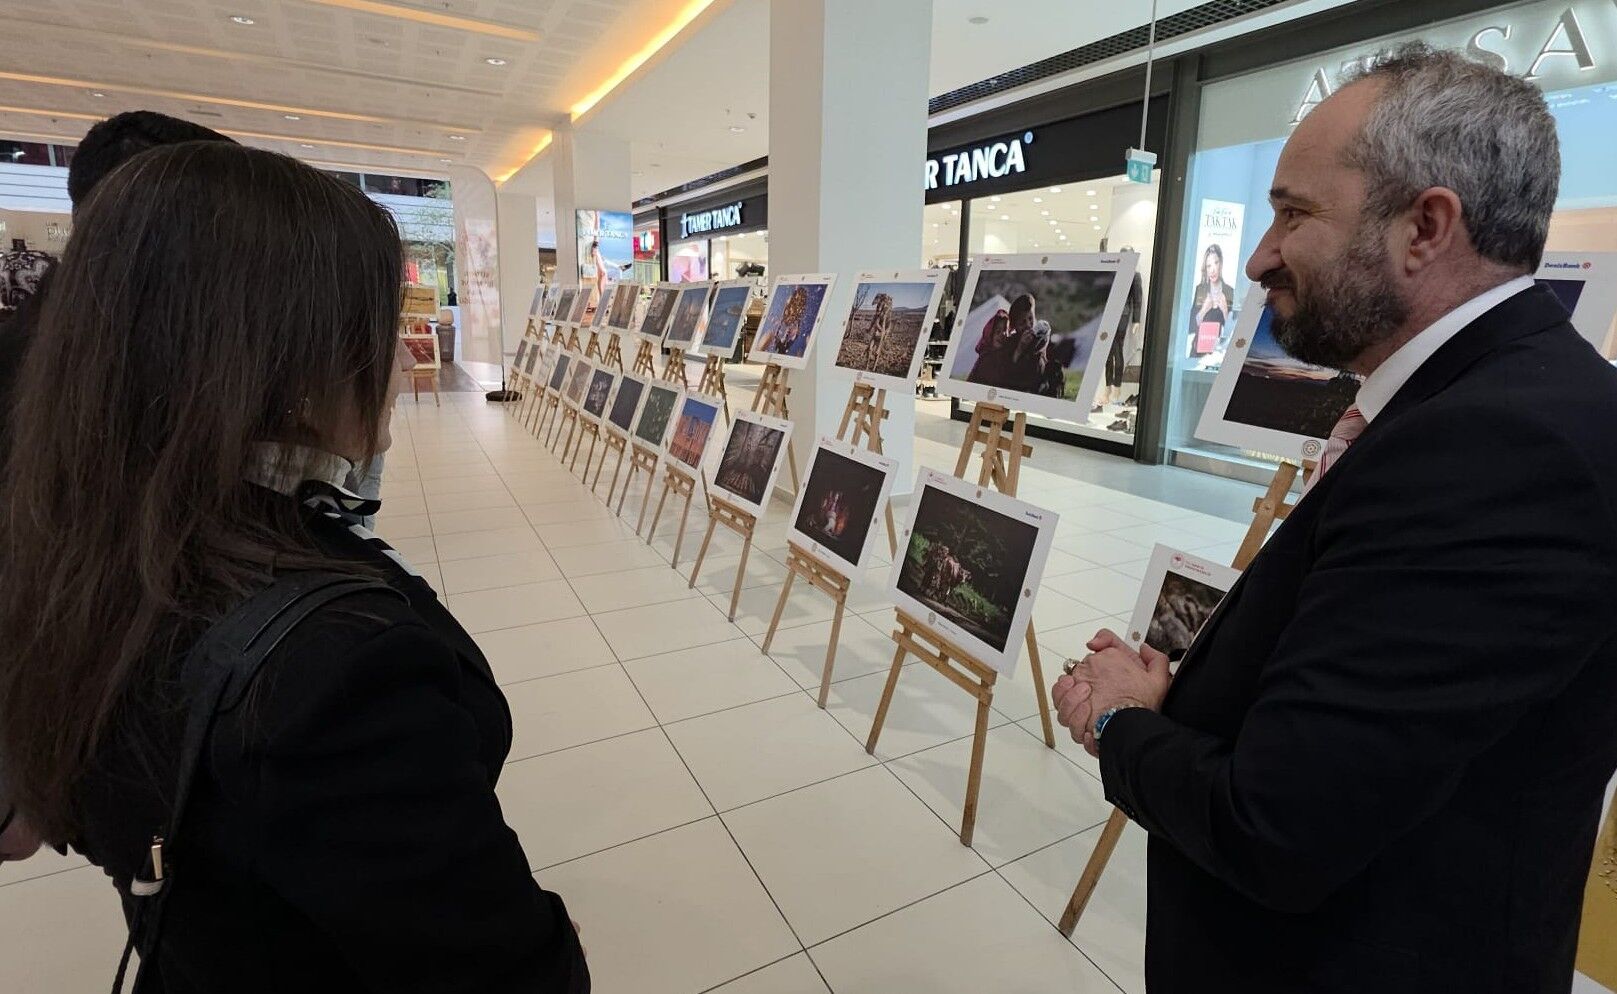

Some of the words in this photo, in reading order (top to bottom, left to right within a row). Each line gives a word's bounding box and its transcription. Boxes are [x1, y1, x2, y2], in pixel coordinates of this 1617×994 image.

[942, 139, 1026, 186] TANCA
[687, 212, 712, 234] TAMER
[711, 205, 741, 229] TANCA
